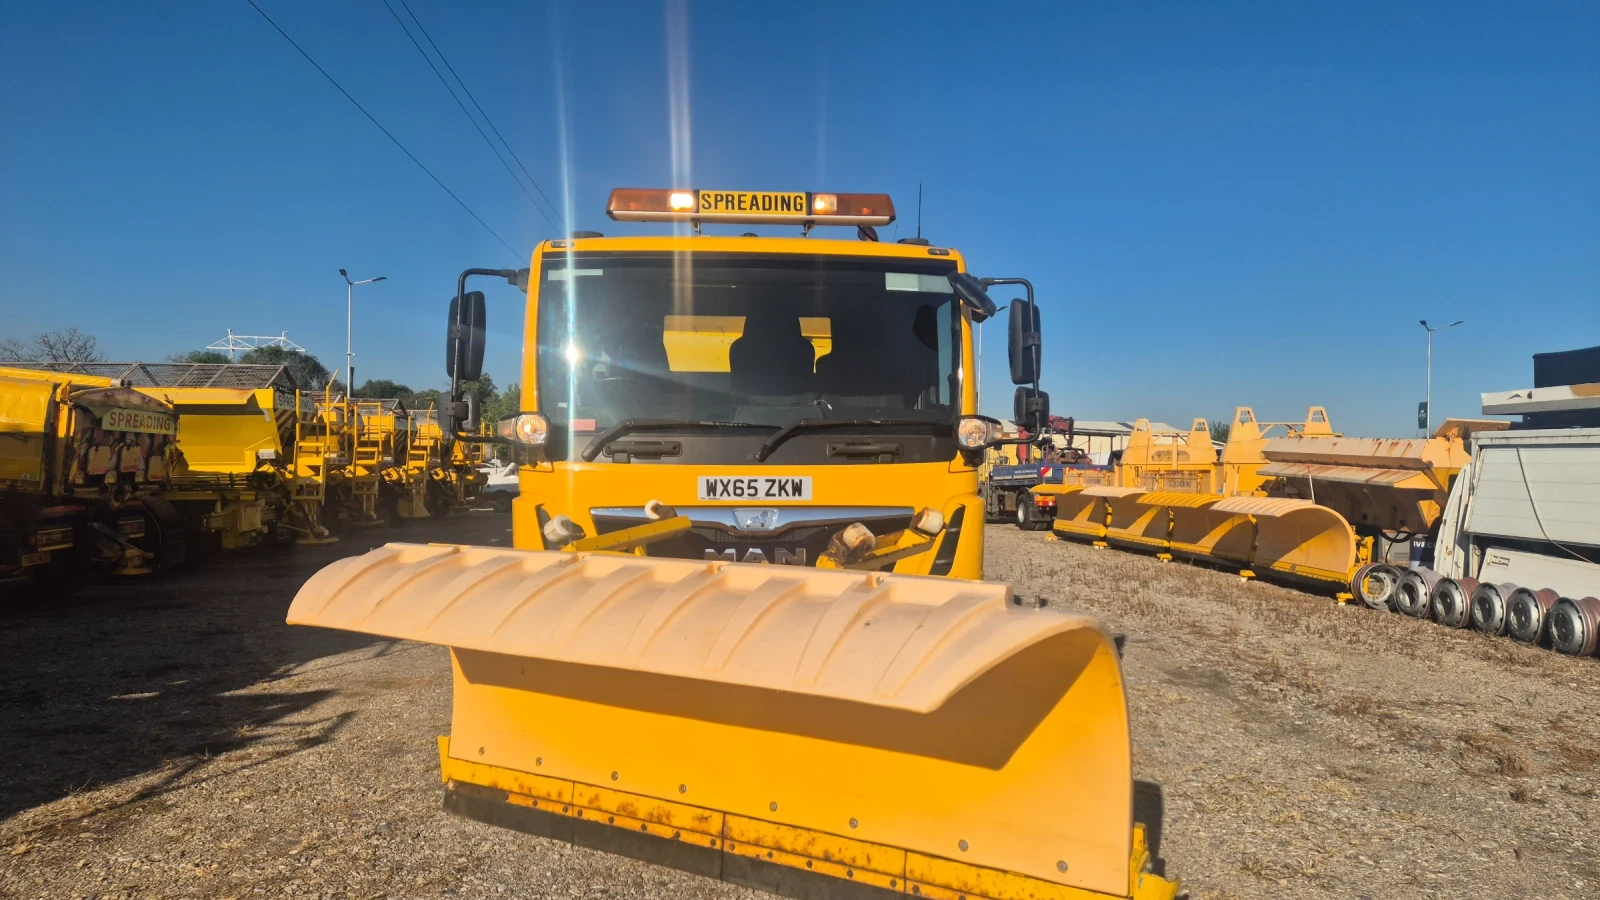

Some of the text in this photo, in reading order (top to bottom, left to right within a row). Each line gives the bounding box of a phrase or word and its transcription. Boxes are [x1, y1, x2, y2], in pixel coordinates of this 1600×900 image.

[701, 193, 804, 212] SPREADING
[278, 394, 312, 411] SPREING
[109, 411, 172, 432] SPREADING
[706, 478, 803, 497] WX65 ZKW
[704, 547, 806, 566] MAN
